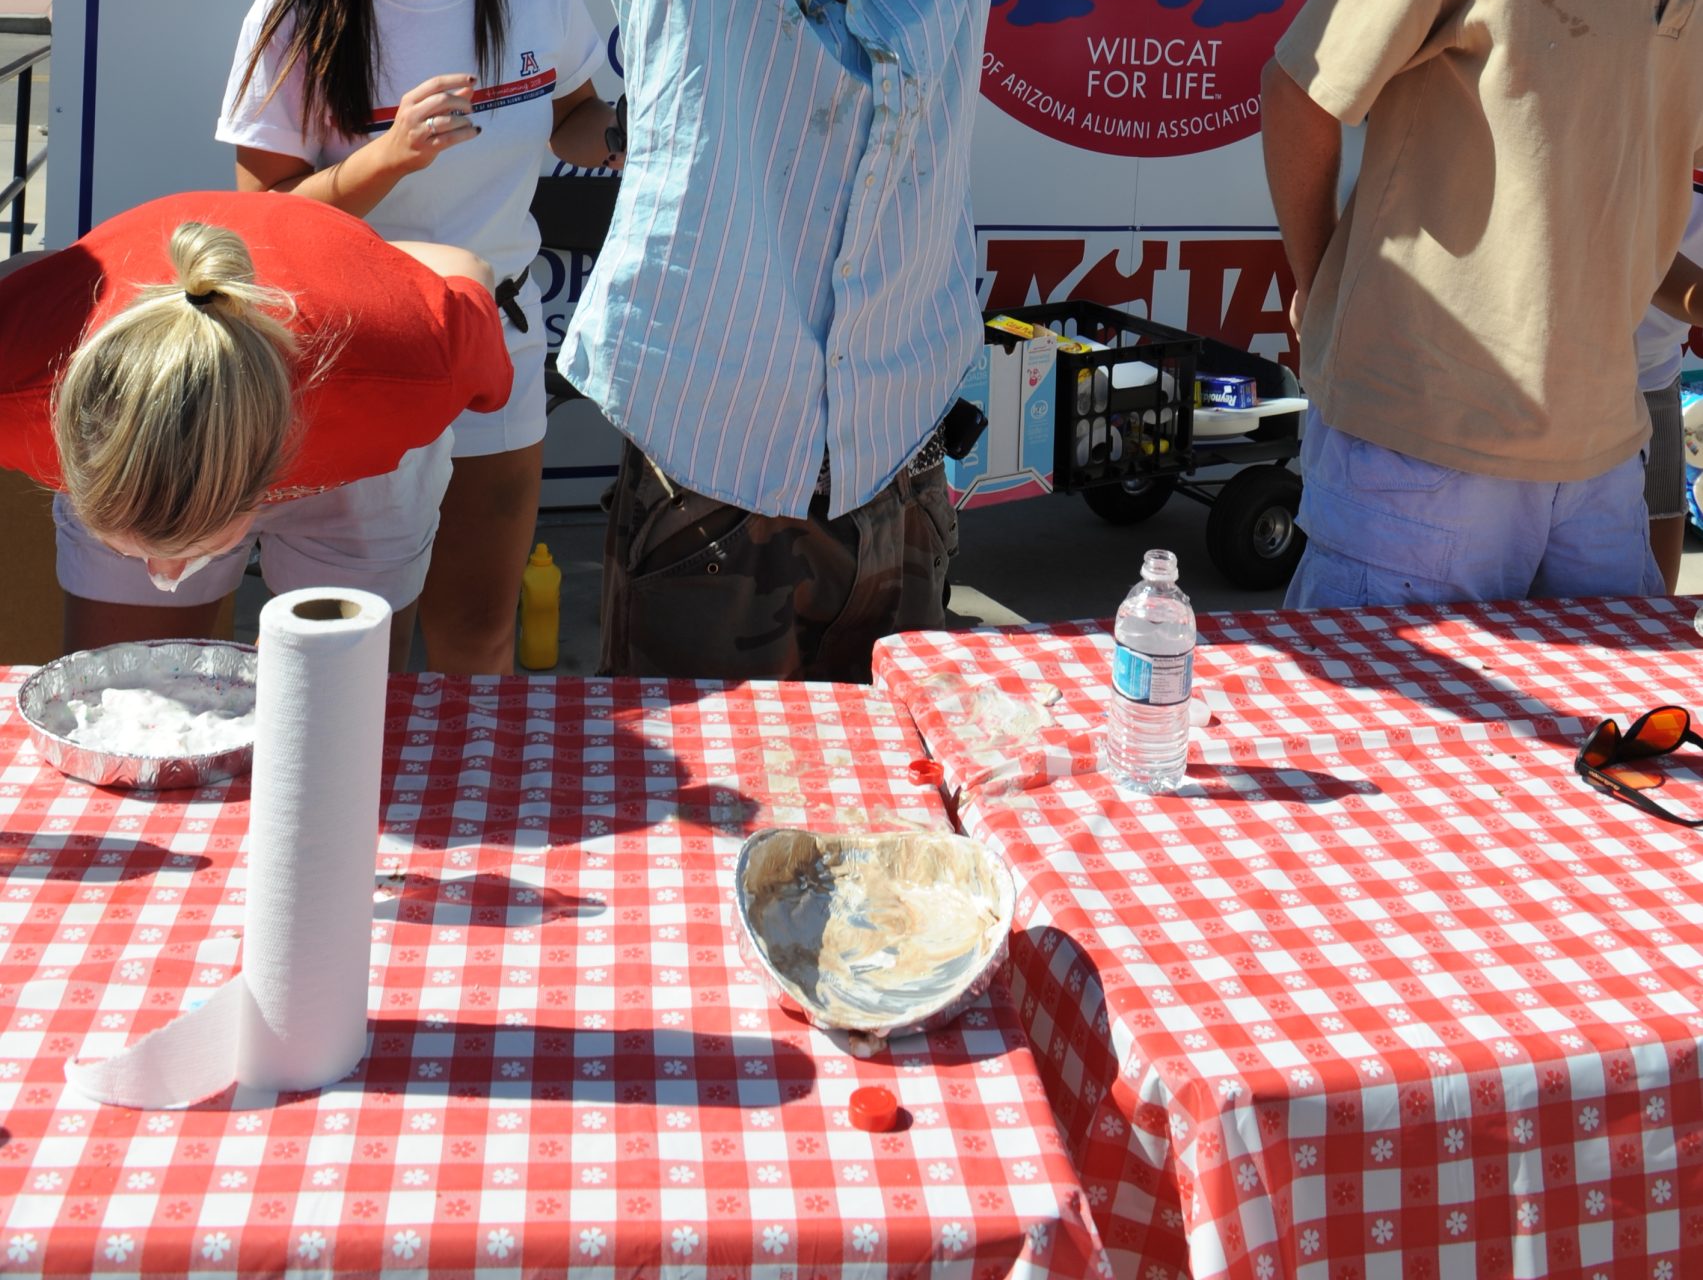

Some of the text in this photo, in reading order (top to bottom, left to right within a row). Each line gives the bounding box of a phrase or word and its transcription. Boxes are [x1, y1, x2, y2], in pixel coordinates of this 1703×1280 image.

[1087, 36, 1222, 67] WILDCAT
[982, 51, 1005, 75] OF
[1001, 73, 1076, 125] ARIZONA
[1081, 112, 1151, 139] ALUMNI
[1087, 70, 1147, 99] FOR
